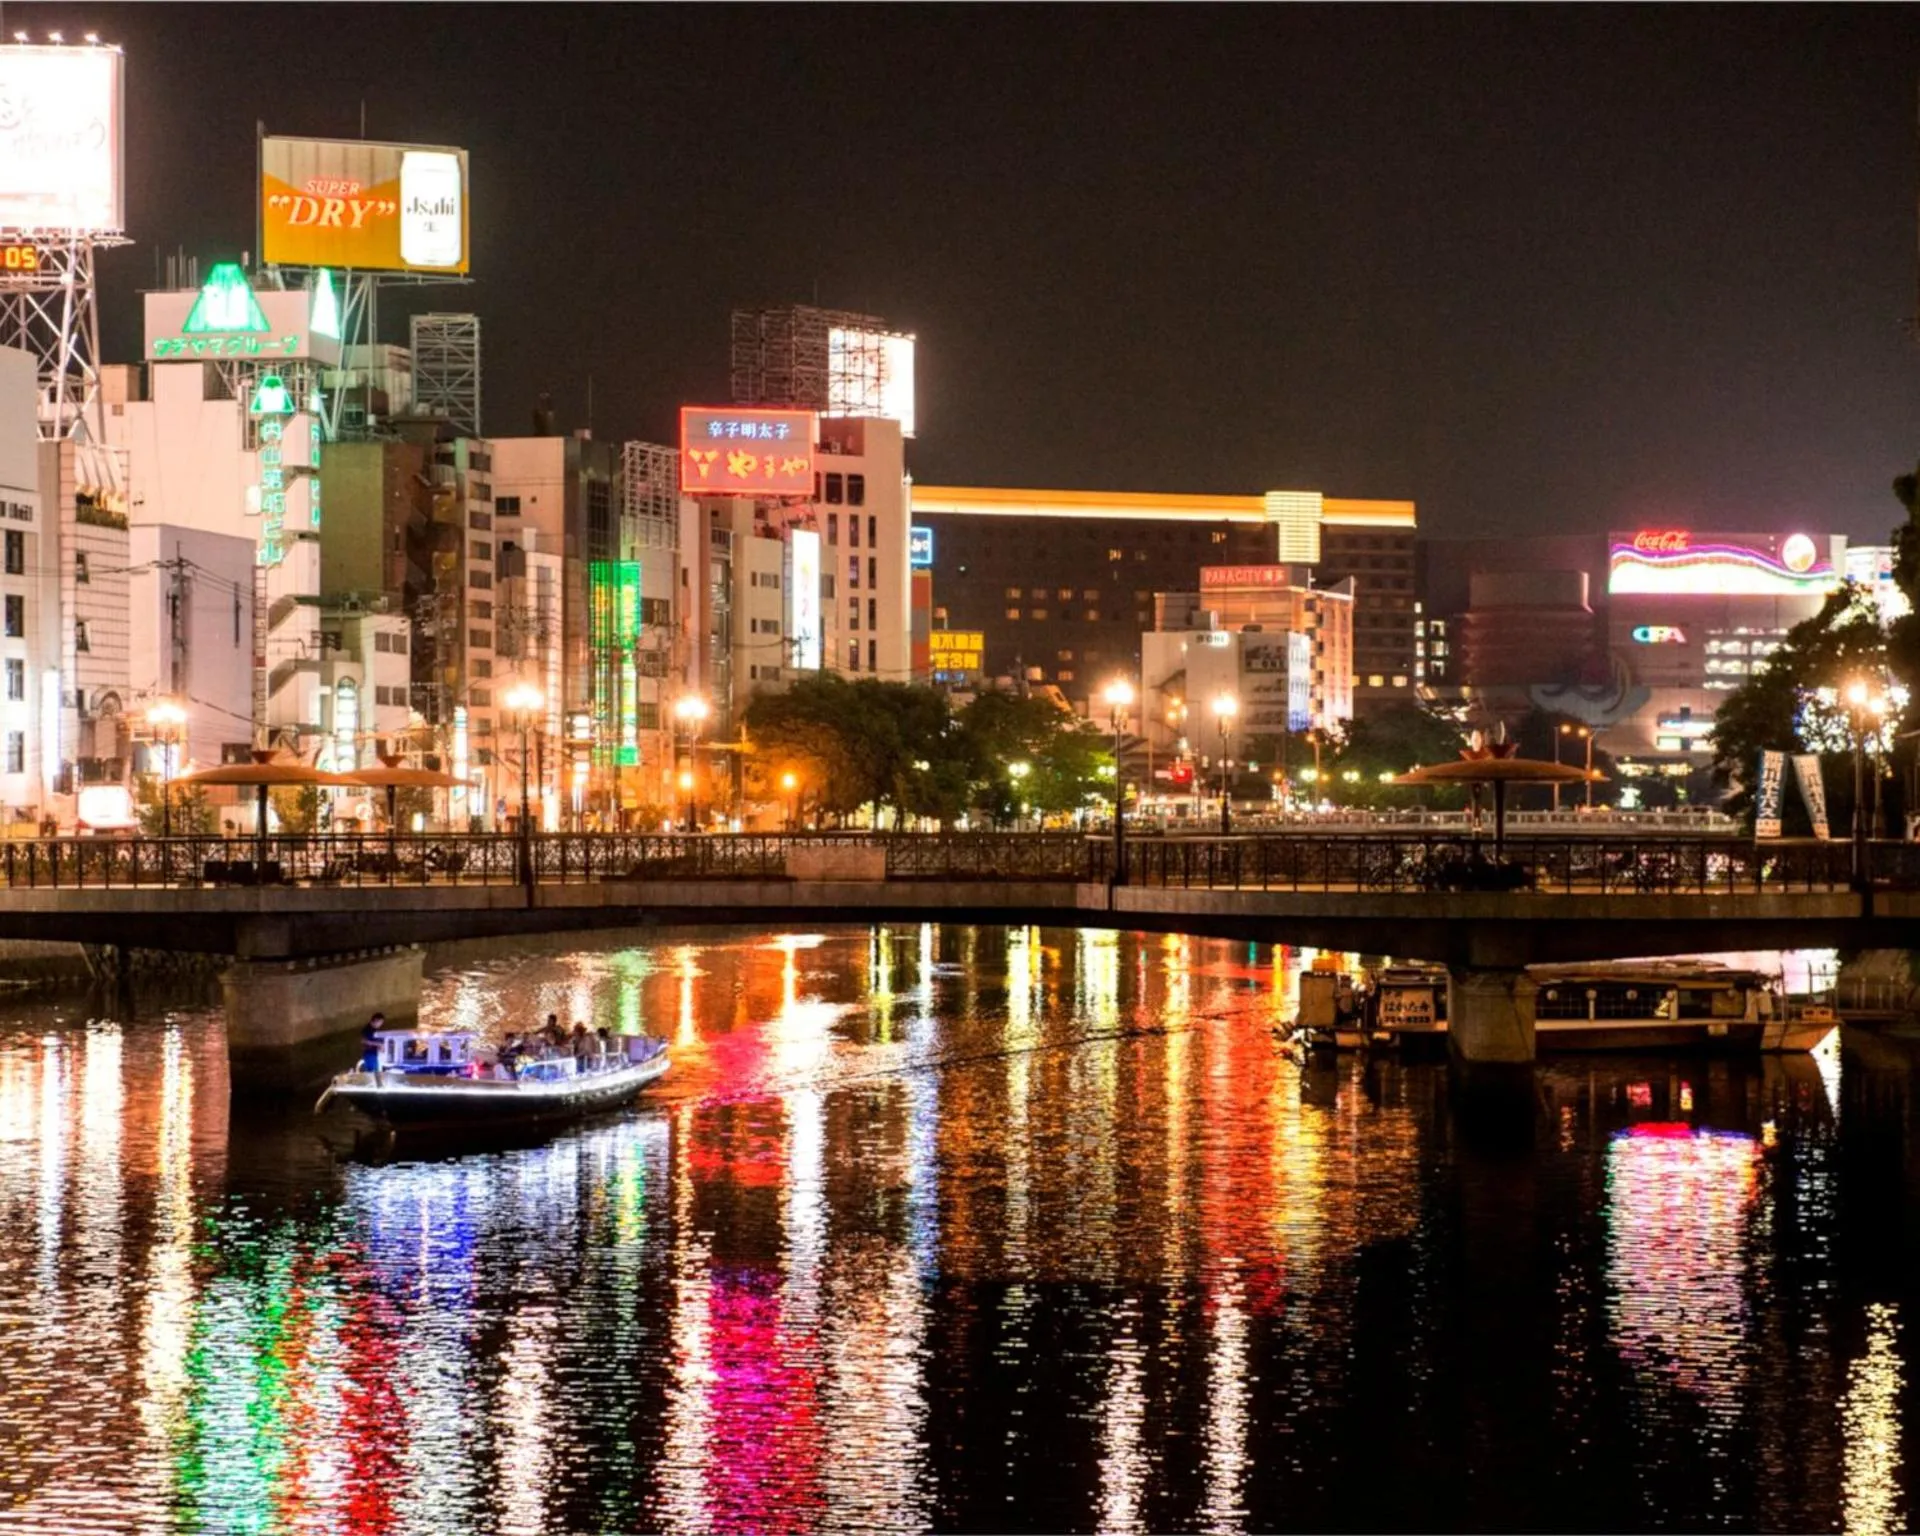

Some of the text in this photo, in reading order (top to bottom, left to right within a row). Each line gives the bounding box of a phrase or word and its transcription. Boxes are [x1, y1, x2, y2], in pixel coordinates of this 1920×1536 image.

[306, 179, 360, 196] SUPER
[707, 420, 790, 439] 辛子明太子
